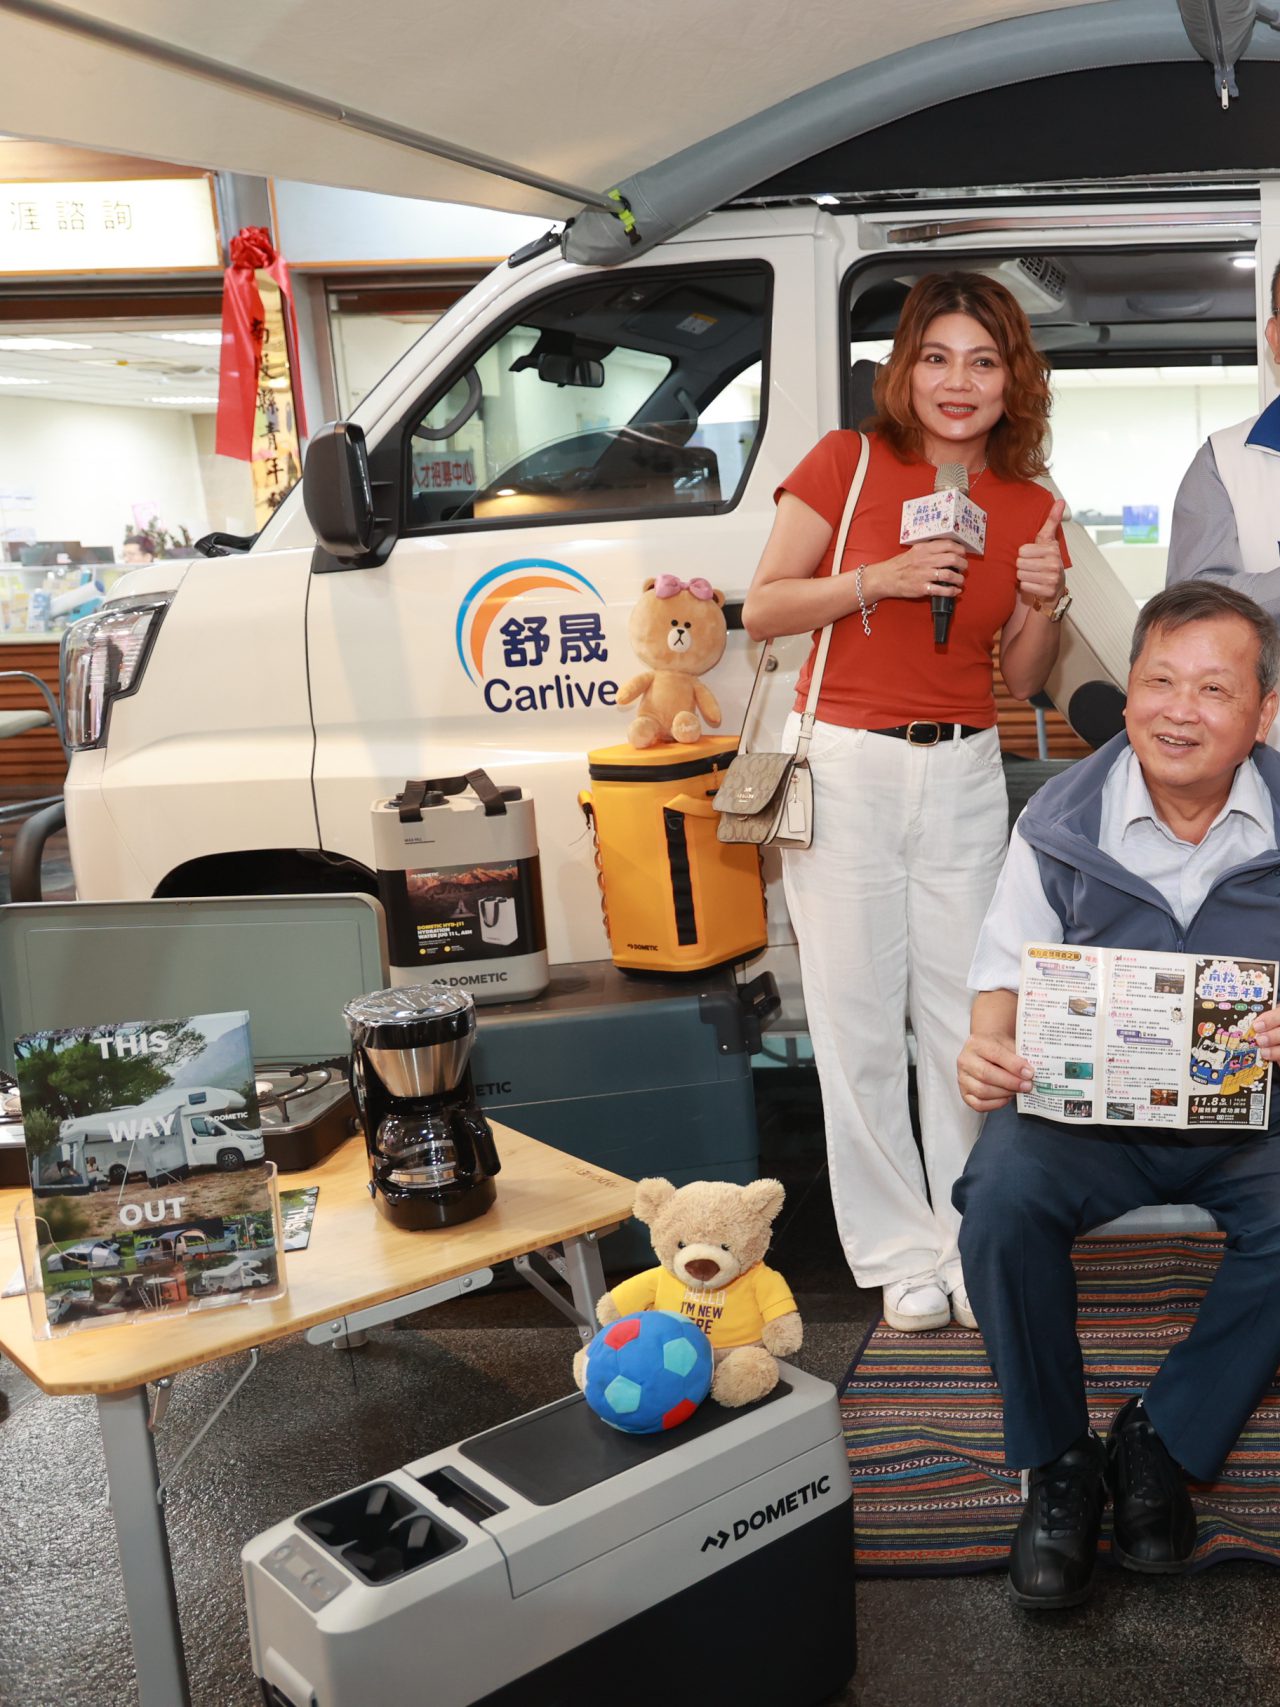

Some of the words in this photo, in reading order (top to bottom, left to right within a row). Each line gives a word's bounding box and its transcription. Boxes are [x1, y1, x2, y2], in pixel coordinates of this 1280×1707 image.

[499, 612, 608, 668] 舒晟
[484, 674, 619, 713] Carlive
[450, 972, 508, 987] DOMETIC
[93, 1031, 170, 1060] THIS
[476, 1081, 512, 1096] ETIC
[1193, 1097, 1219, 1106] 11.8
[214, 1111, 248, 1122] DOMETIC
[106, 1114, 177, 1143] WAY
[117, 1197, 186, 1226] OUT
[681, 1301, 696, 1316] I'M
[697, 1304, 724, 1319] NEW
[689, 1317, 713, 1334] RE
[733, 1475, 831, 1541] DOMETIC
